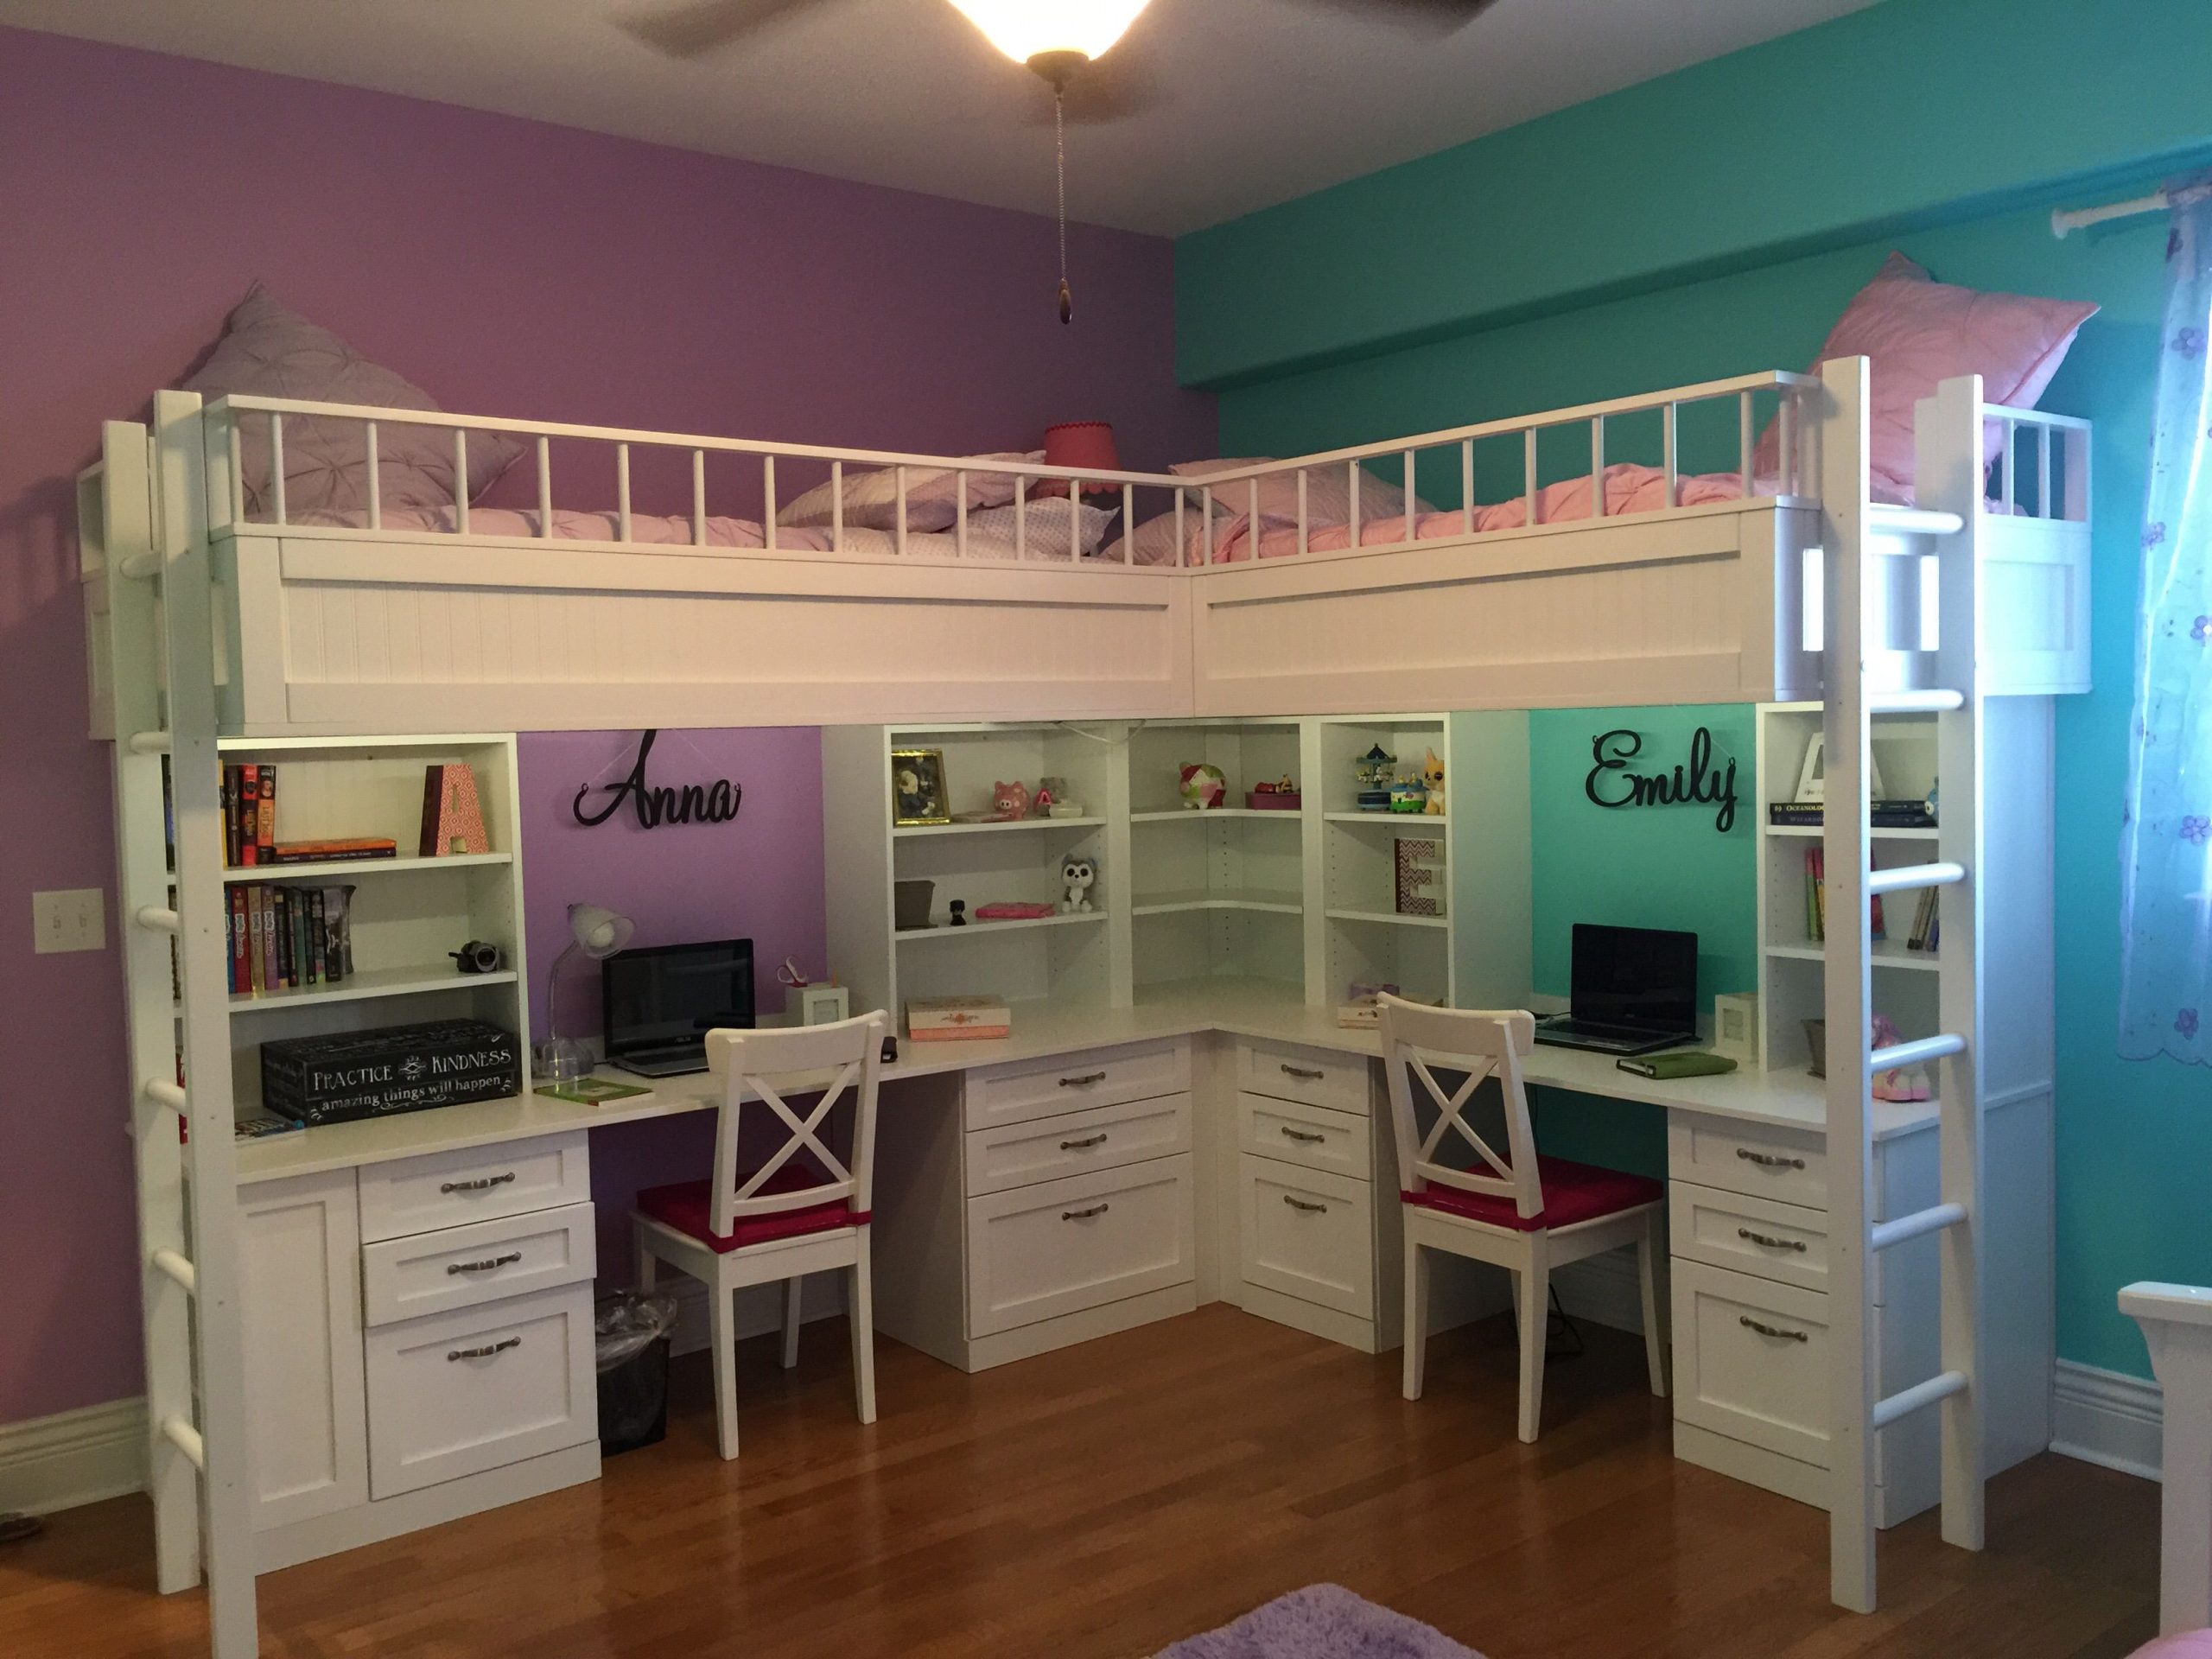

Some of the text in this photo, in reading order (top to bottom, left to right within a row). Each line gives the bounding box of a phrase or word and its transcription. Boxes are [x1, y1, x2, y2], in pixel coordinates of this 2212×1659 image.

[419, 764, 490, 857] A
[574, 729, 741, 830] Anna
[1586, 727, 1738, 832] Emily
[314, 1065, 393, 1090] PRACTICE
[432, 1048, 512, 1074] KINDNESS
[321, 1076, 501, 1111] amazing things will happen
